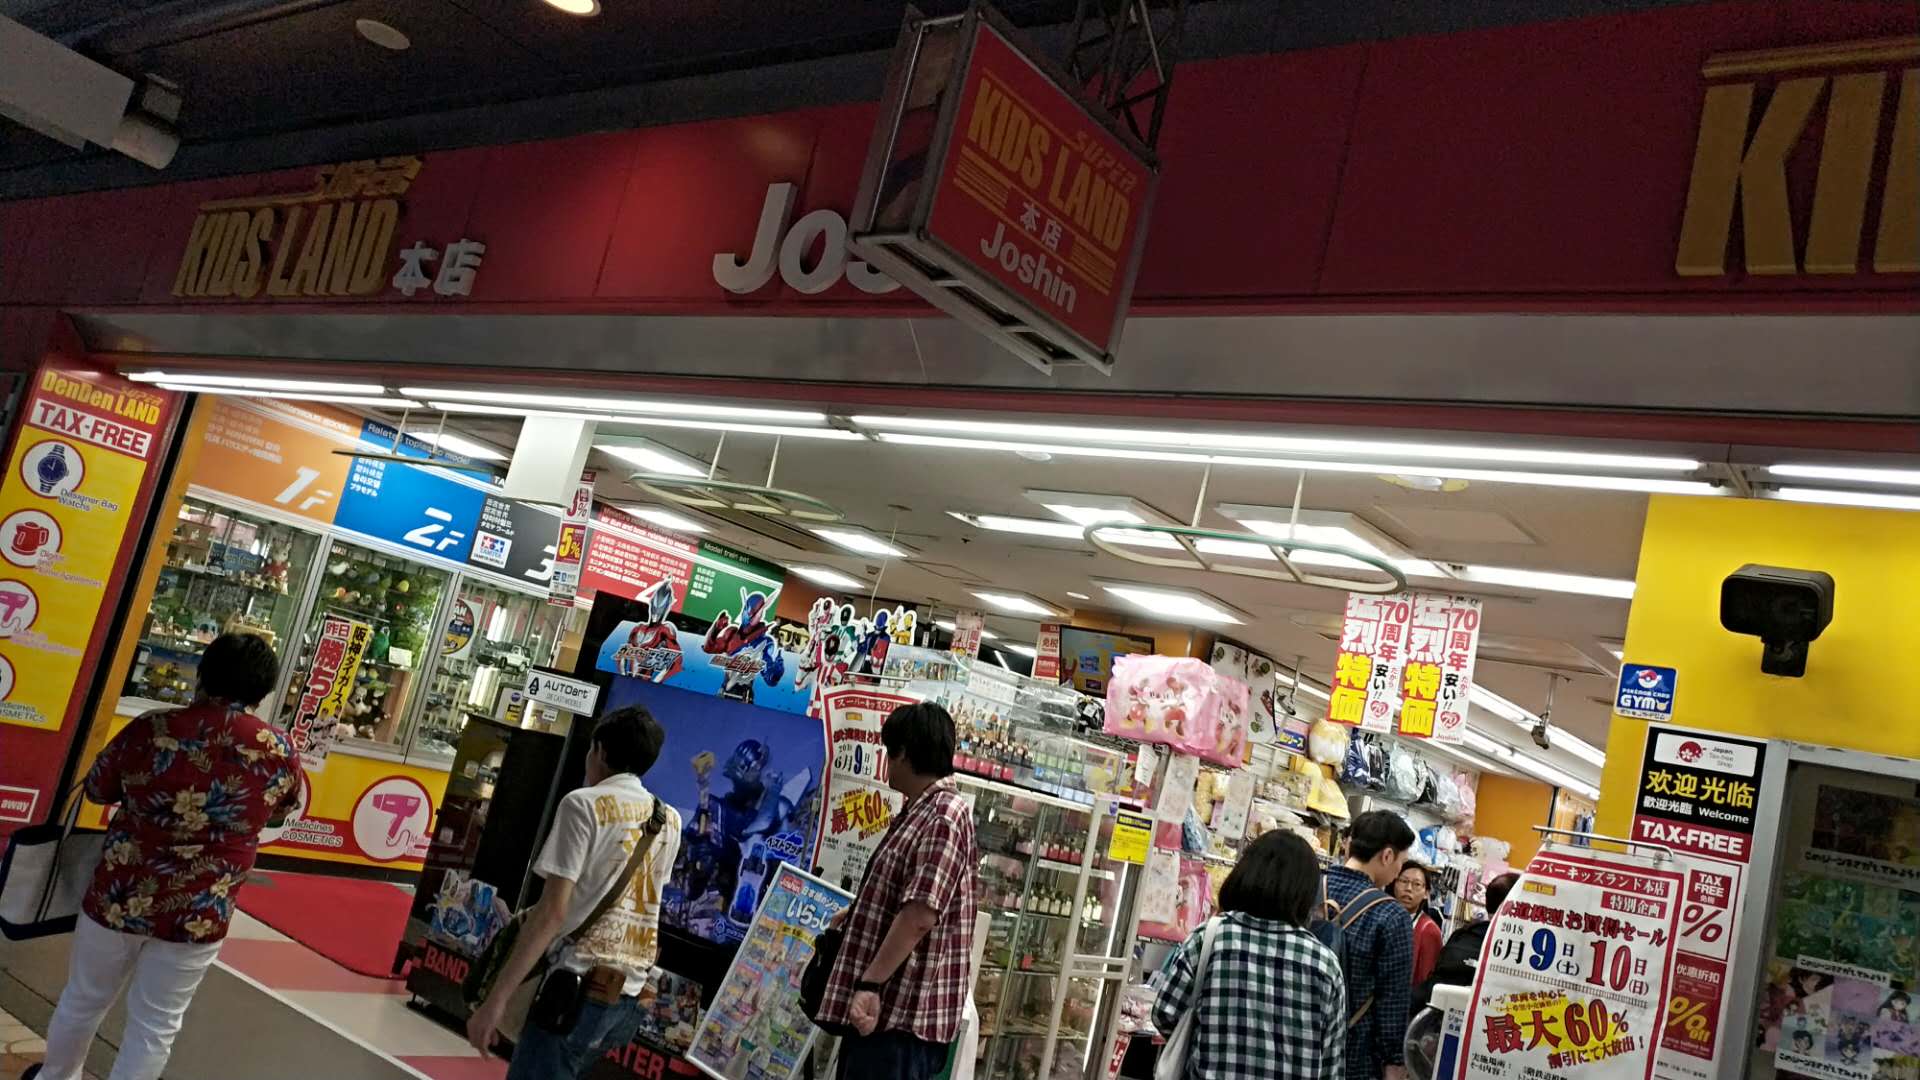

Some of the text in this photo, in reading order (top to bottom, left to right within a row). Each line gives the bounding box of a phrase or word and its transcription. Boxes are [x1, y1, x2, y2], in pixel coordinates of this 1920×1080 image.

[967, 76, 1131, 251] KIDS LAND
[1019, 200, 1063, 250] 本店
[171, 199, 400, 298] KIDS LAND
[392, 237, 486, 297] 本店
[980, 221, 1077, 313] Joshin
[40, 370, 161, 426] DenDen LAND
[40, 402, 147, 454] TAX-FREE
[101, 499, 118, 512] Bag
[402, 507, 466, 551] 2F
[326, 619, 350, 638] 昨日
[1376, 600, 1409, 662] 70周年
[1446, 608, 1479, 672] 70周年
[331, 625, 368, 704] 阪神タイガース
[291, 637, 347, 753] 勝ちました
[543, 680, 589, 699] AUTOart
[1620, 694, 1656, 710] GYM
[1712, 745, 1733, 755] Japan
[1645, 769, 1755, 808] 欢迎光临
[283, 817, 335, 833] Medicines
[1698, 807, 1749, 825] Welcome
[281, 831, 343, 847] COSMETICS
[1640, 820, 1744, 856] TAX-FREE
[1694, 883, 1725, 898] FREE
[1699, 873, 1722, 887] TAX
[1609, 896, 1661, 918] 特別企画
[1501, 922, 1524, 936] 2018
[1677, 963, 1720, 985] 优惠折扣
[1483, 999, 1629, 1053] 最大60%
